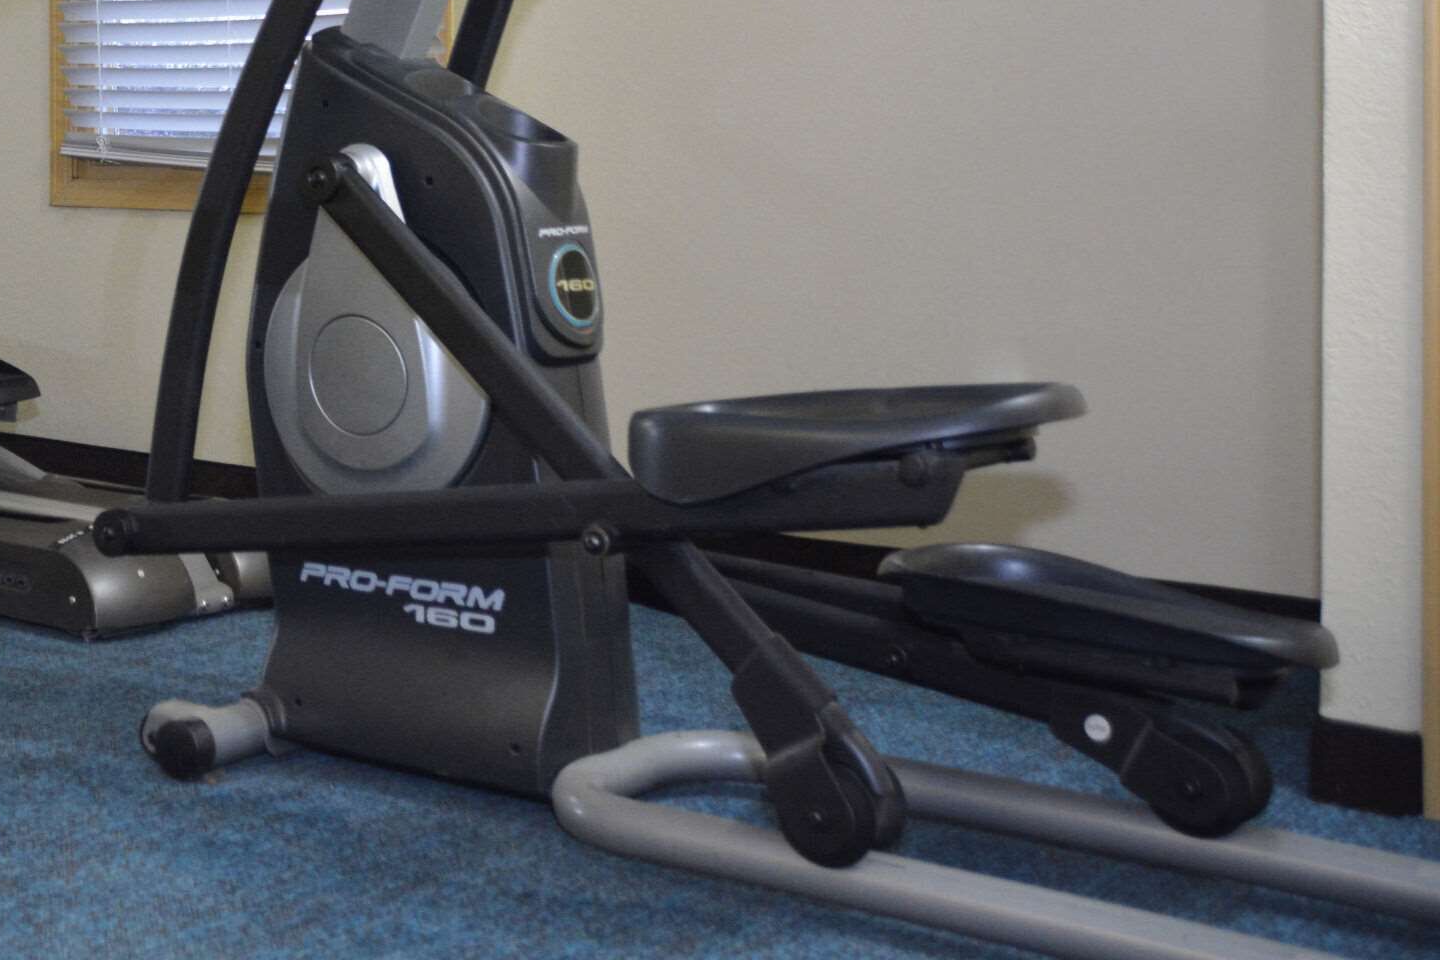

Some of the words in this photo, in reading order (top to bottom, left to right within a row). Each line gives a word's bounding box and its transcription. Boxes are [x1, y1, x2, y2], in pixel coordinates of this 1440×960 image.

[538, 225, 588, 238] PRO-FORM
[556, 279, 594, 292] 160
[300, 562, 506, 611] PRO-FORM
[403, 604, 496, 634] 160
